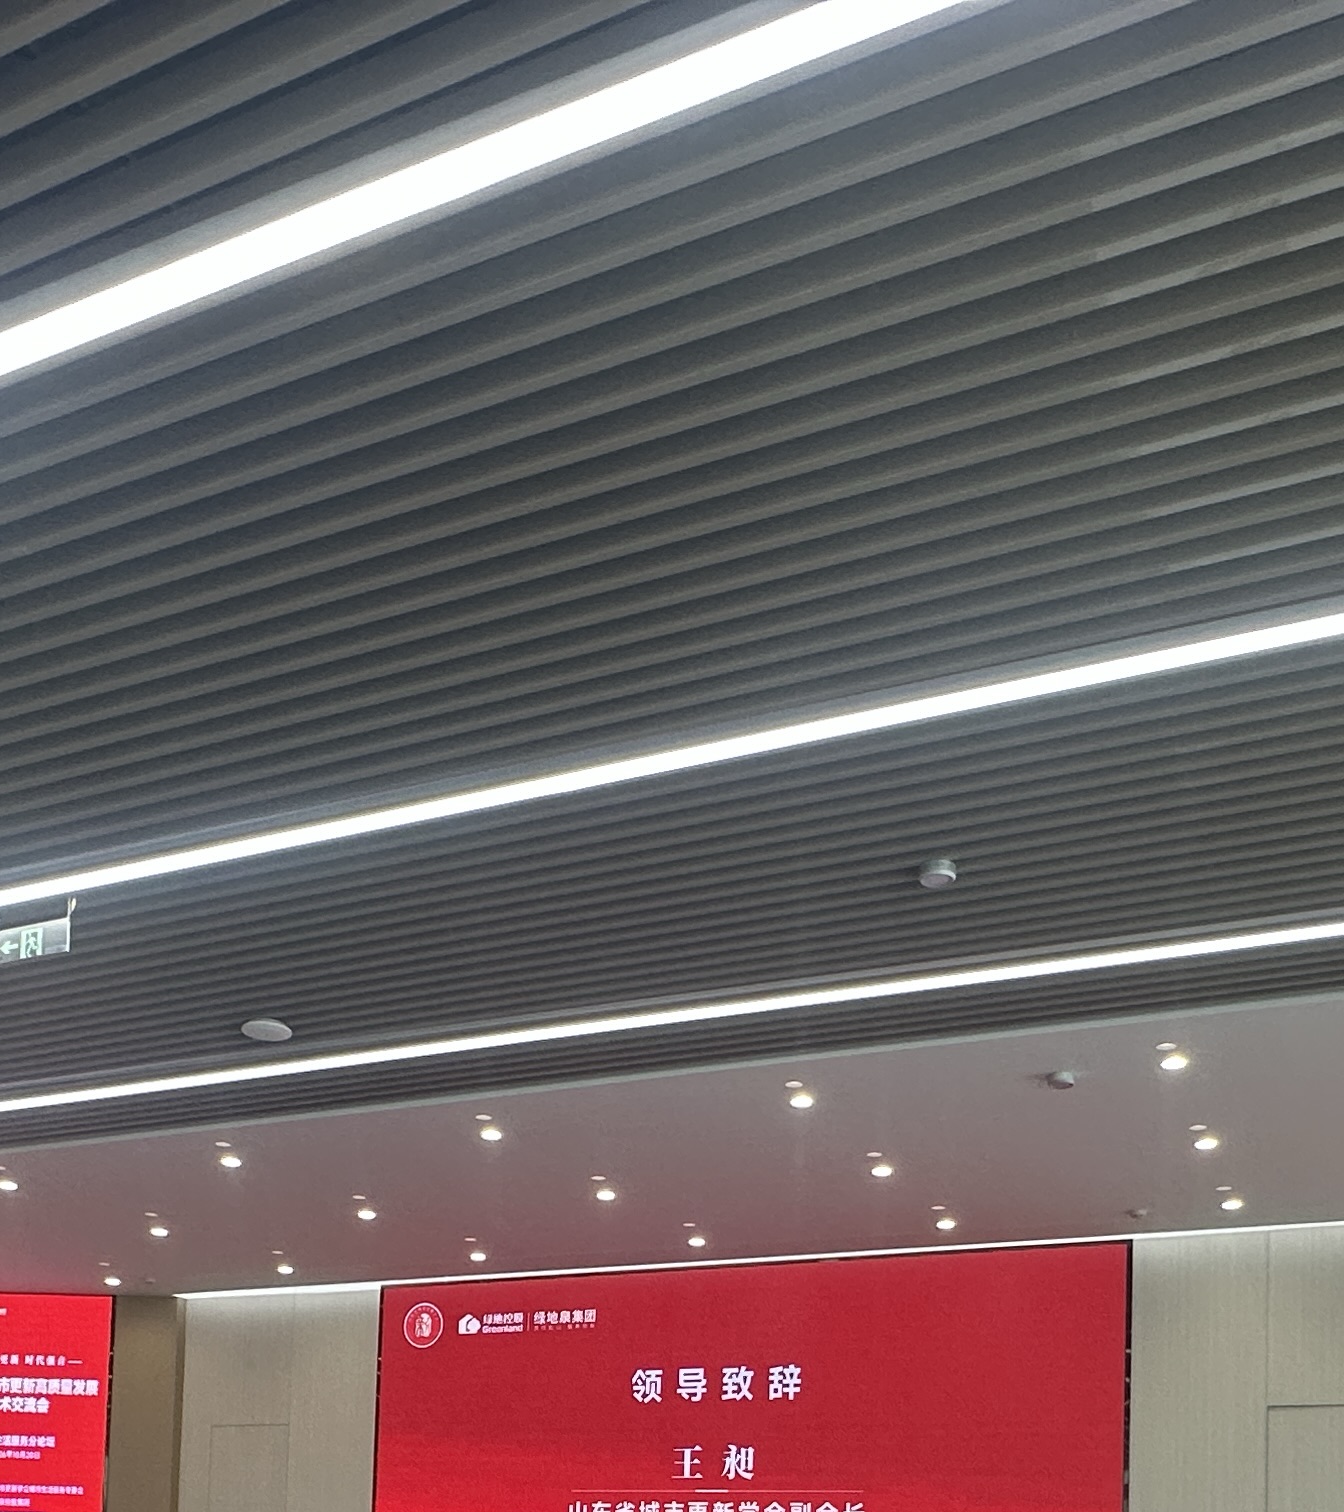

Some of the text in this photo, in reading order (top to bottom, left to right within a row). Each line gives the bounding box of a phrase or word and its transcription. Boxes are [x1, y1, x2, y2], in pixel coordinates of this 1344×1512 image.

[533, 1308, 597, 1326] 绿地泉集团
[631, 1363, 803, 1404] 领导致辞
[671, 1444, 755, 1480] 王昶
